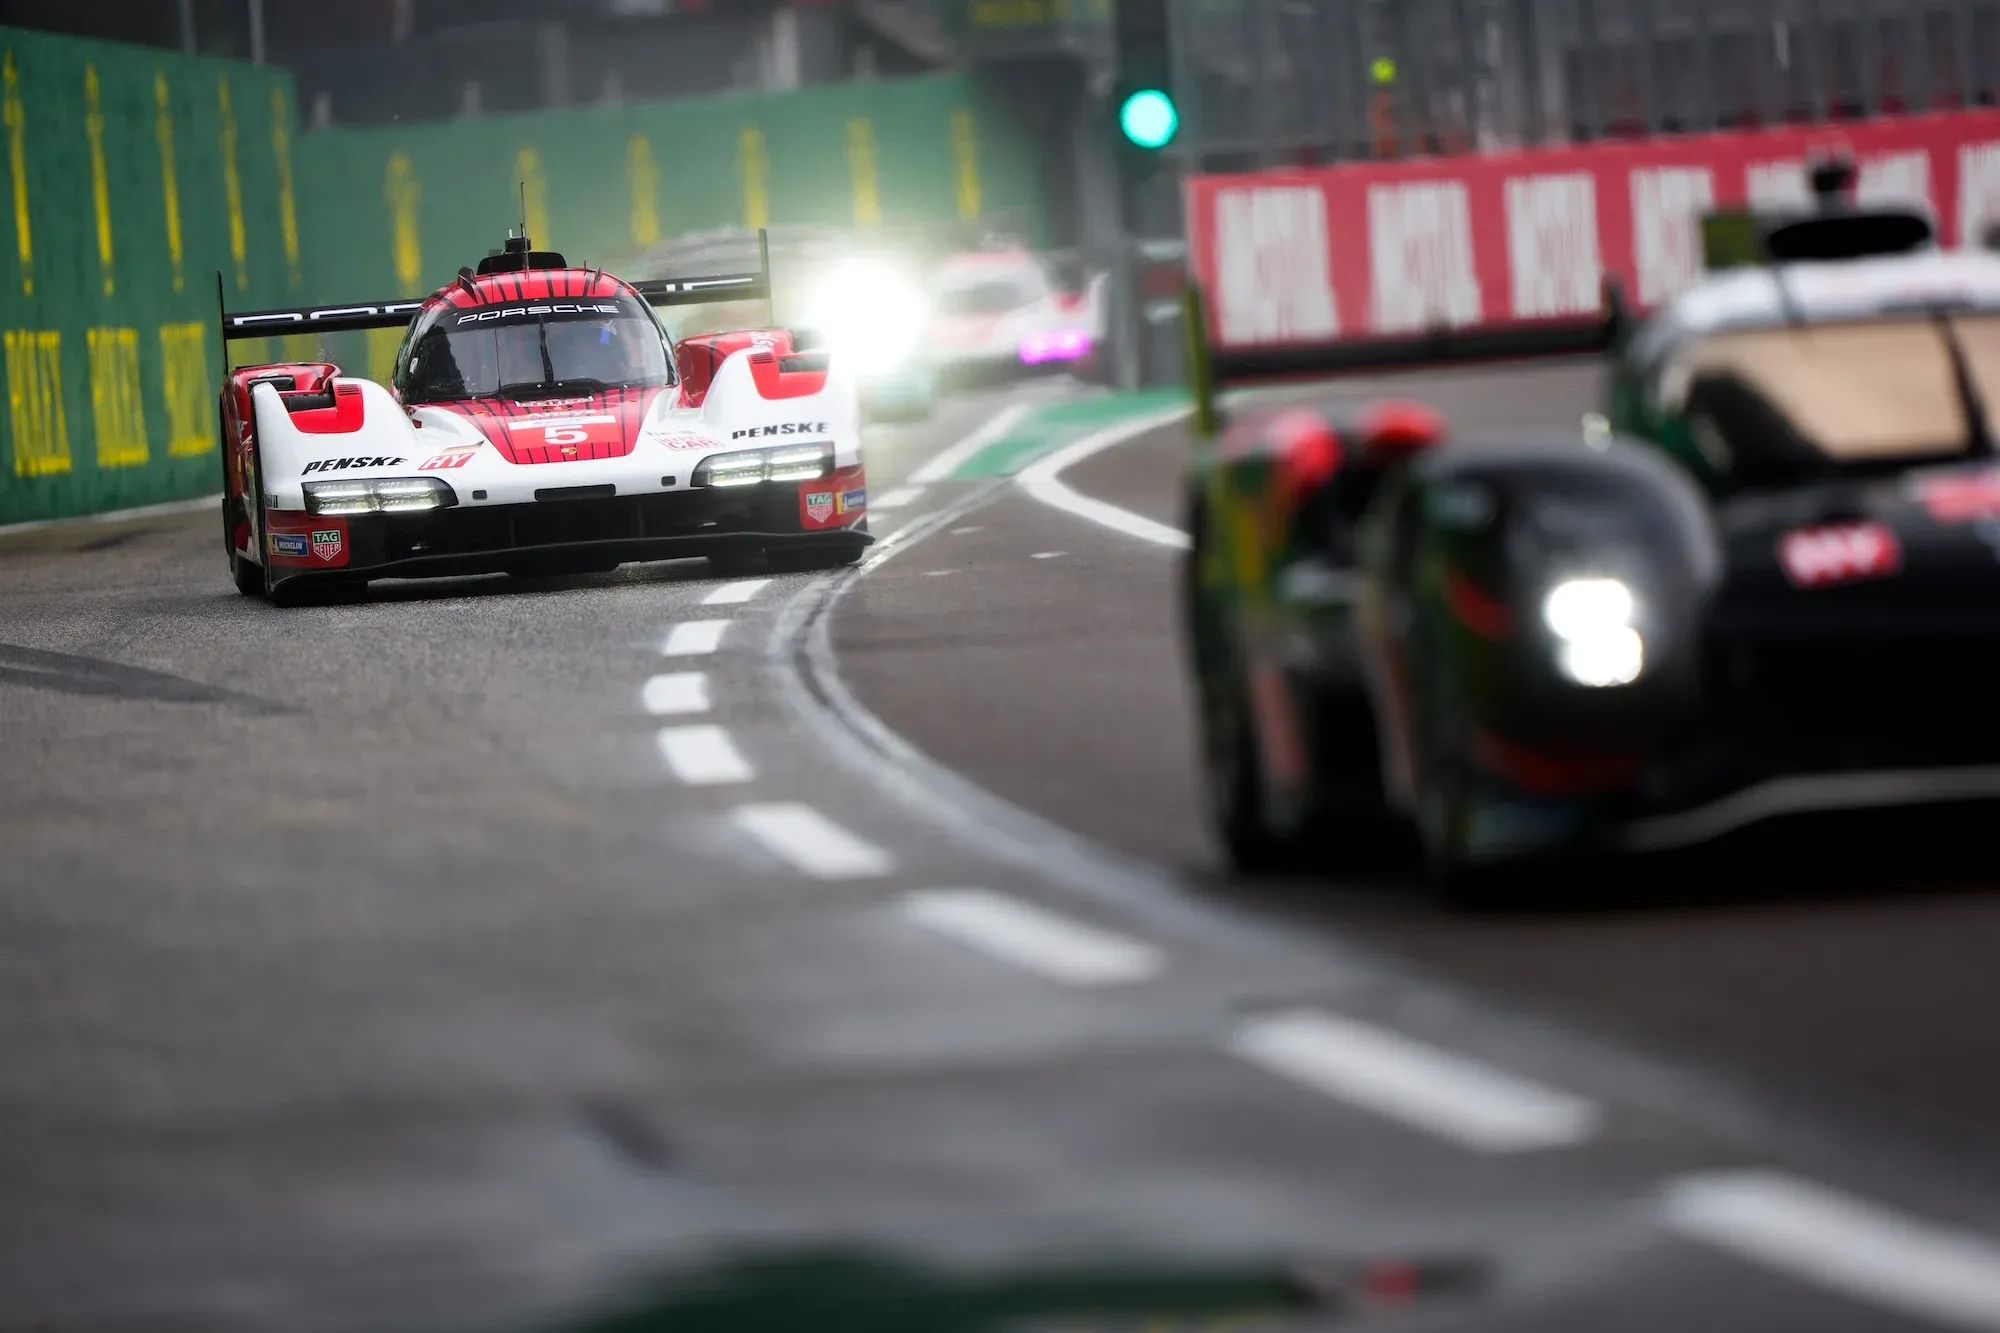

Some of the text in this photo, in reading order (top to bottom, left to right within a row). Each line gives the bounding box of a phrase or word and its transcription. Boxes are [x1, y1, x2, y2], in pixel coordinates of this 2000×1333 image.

[457, 304, 619, 325] PORSCHE
[544, 425, 588, 444] 5
[732, 422, 829, 440] PENSKE
[301, 457, 408, 475] PENSKE
[422, 453, 472, 469] HY
[808, 495, 831, 505] TAG
[279, 541, 302, 549] MICHELIN
[315, 532, 338, 542] TAG
[314, 544, 340, 558] HEUER
